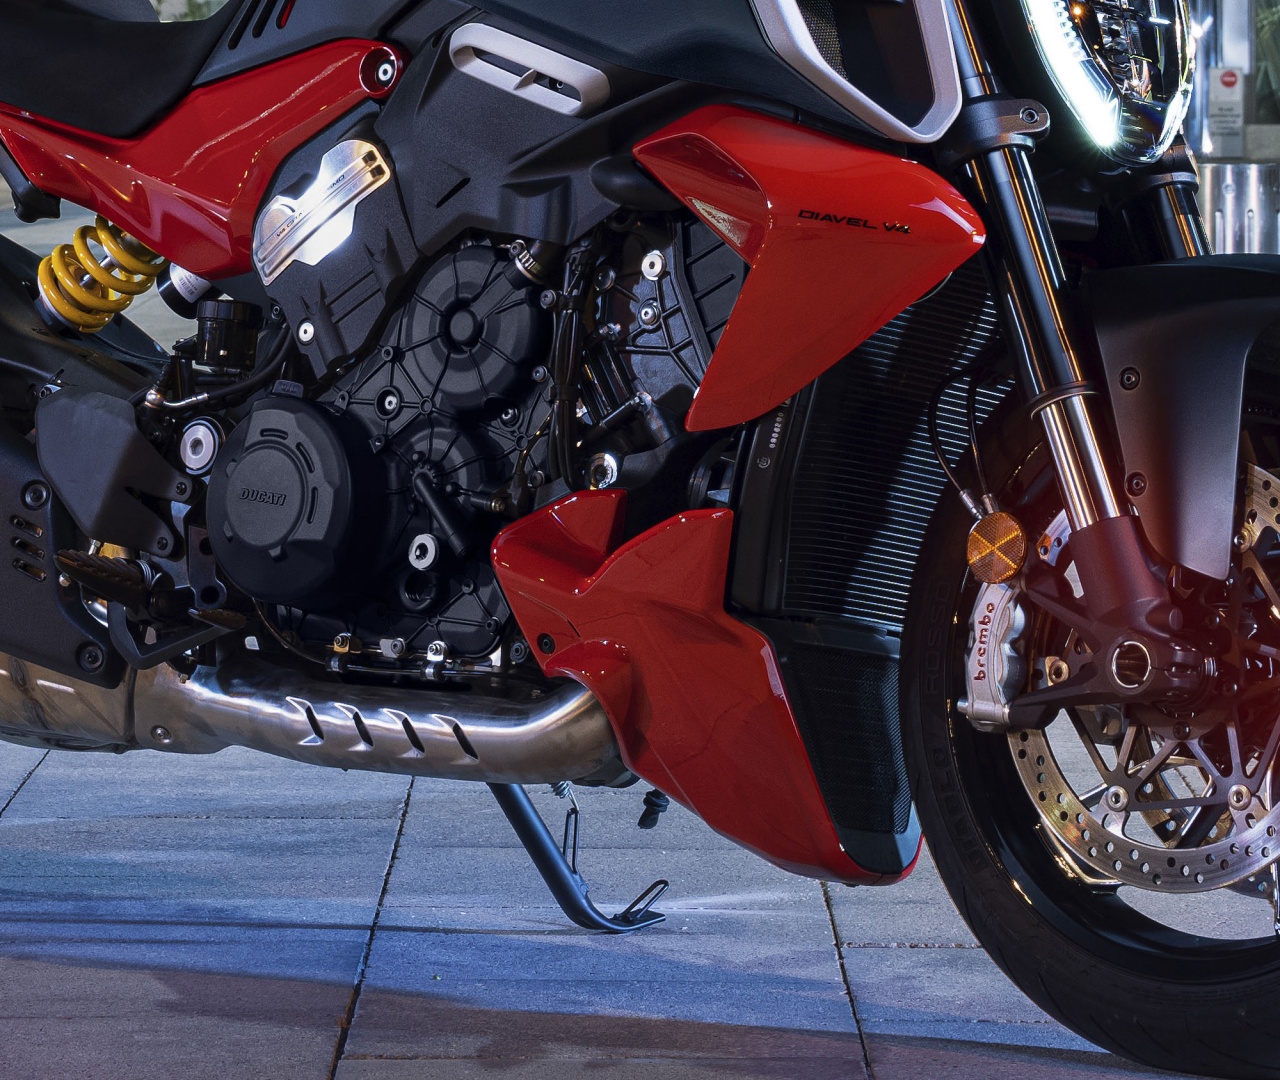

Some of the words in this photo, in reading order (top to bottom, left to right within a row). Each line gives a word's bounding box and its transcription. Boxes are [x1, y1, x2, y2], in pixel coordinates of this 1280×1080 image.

[797, 209, 878, 230] DIAVEL
[883, 221, 911, 235] V4
[239, 487, 287, 507] DUCATI
[925, 580, 953, 696] ROSSO
[973, 602, 995, 681] brembo
